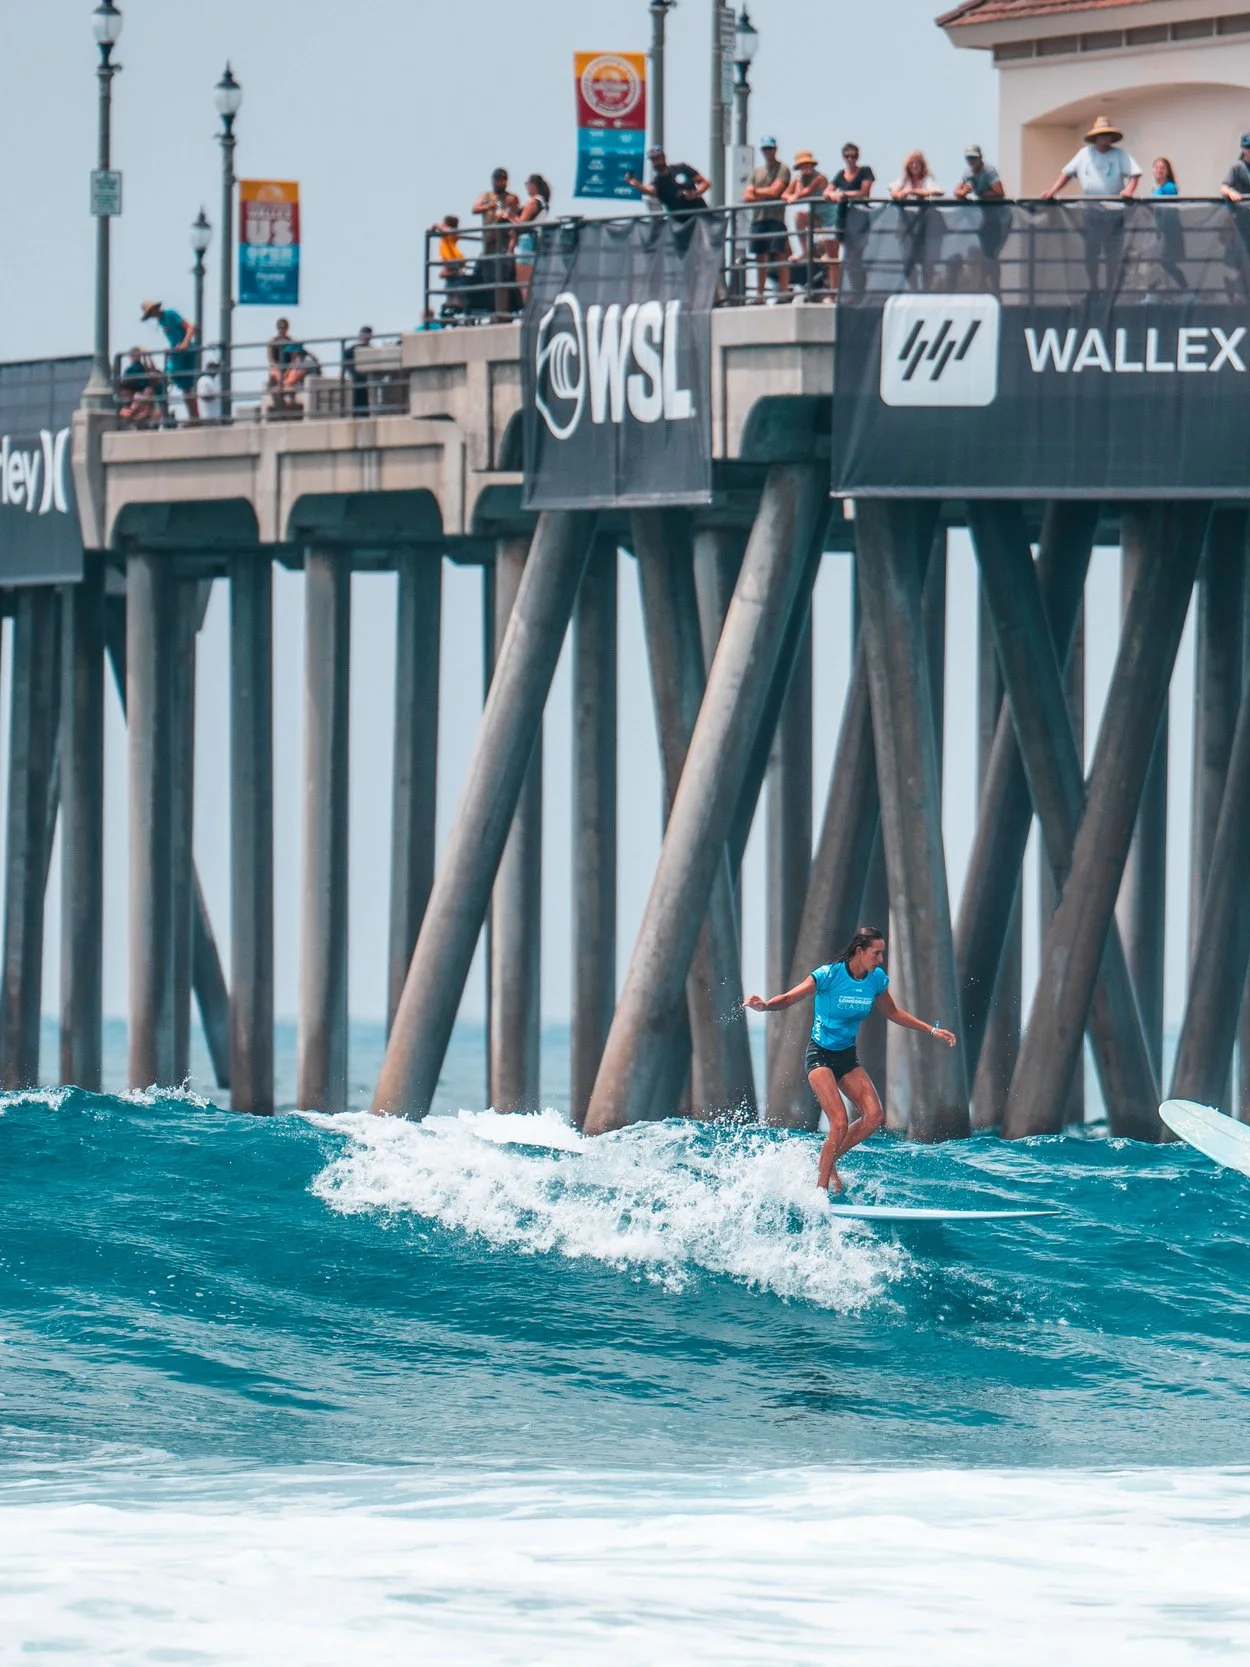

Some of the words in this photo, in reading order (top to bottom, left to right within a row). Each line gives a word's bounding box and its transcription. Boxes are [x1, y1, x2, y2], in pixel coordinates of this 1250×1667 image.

[246, 220, 292, 245] US
[586, 300, 692, 423] WSL
[0, 434, 41, 512] ley
